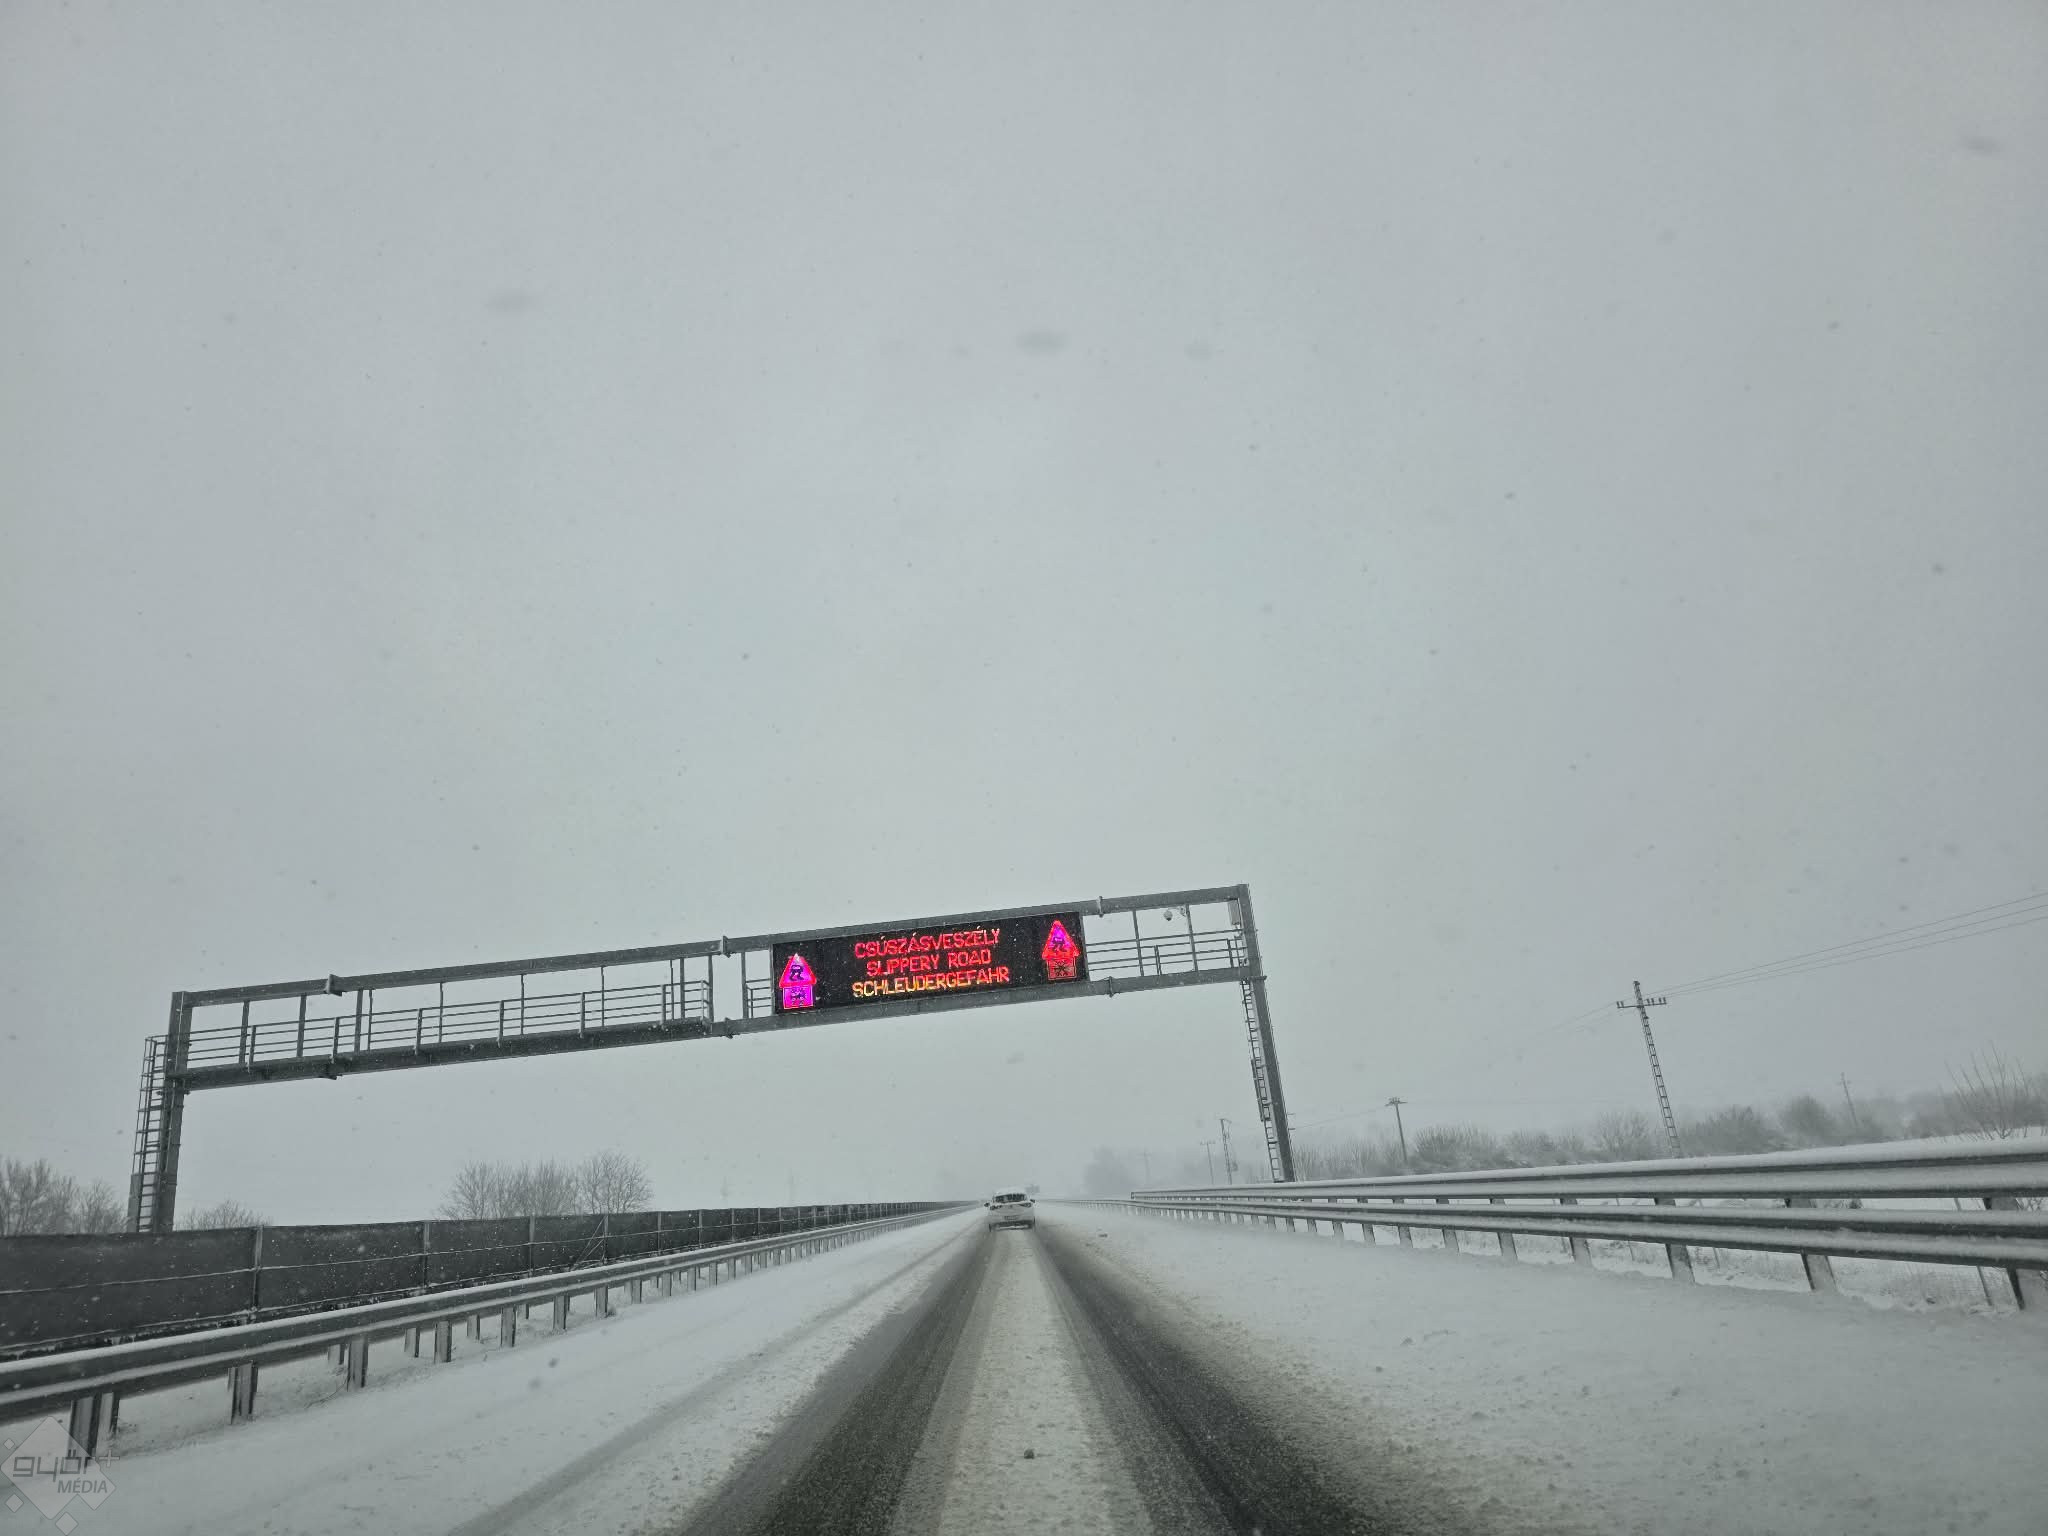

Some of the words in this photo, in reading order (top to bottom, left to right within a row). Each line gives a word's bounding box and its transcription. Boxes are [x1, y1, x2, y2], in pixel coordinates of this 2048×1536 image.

[854, 926, 1001, 959] CSÚSZÁSVESZÉLY
[866, 954, 939, 977] SLIPPERY
[948, 949, 991, 967] ROAD
[852, 966, 1009, 998] SCHLEUDERGEFAHR
